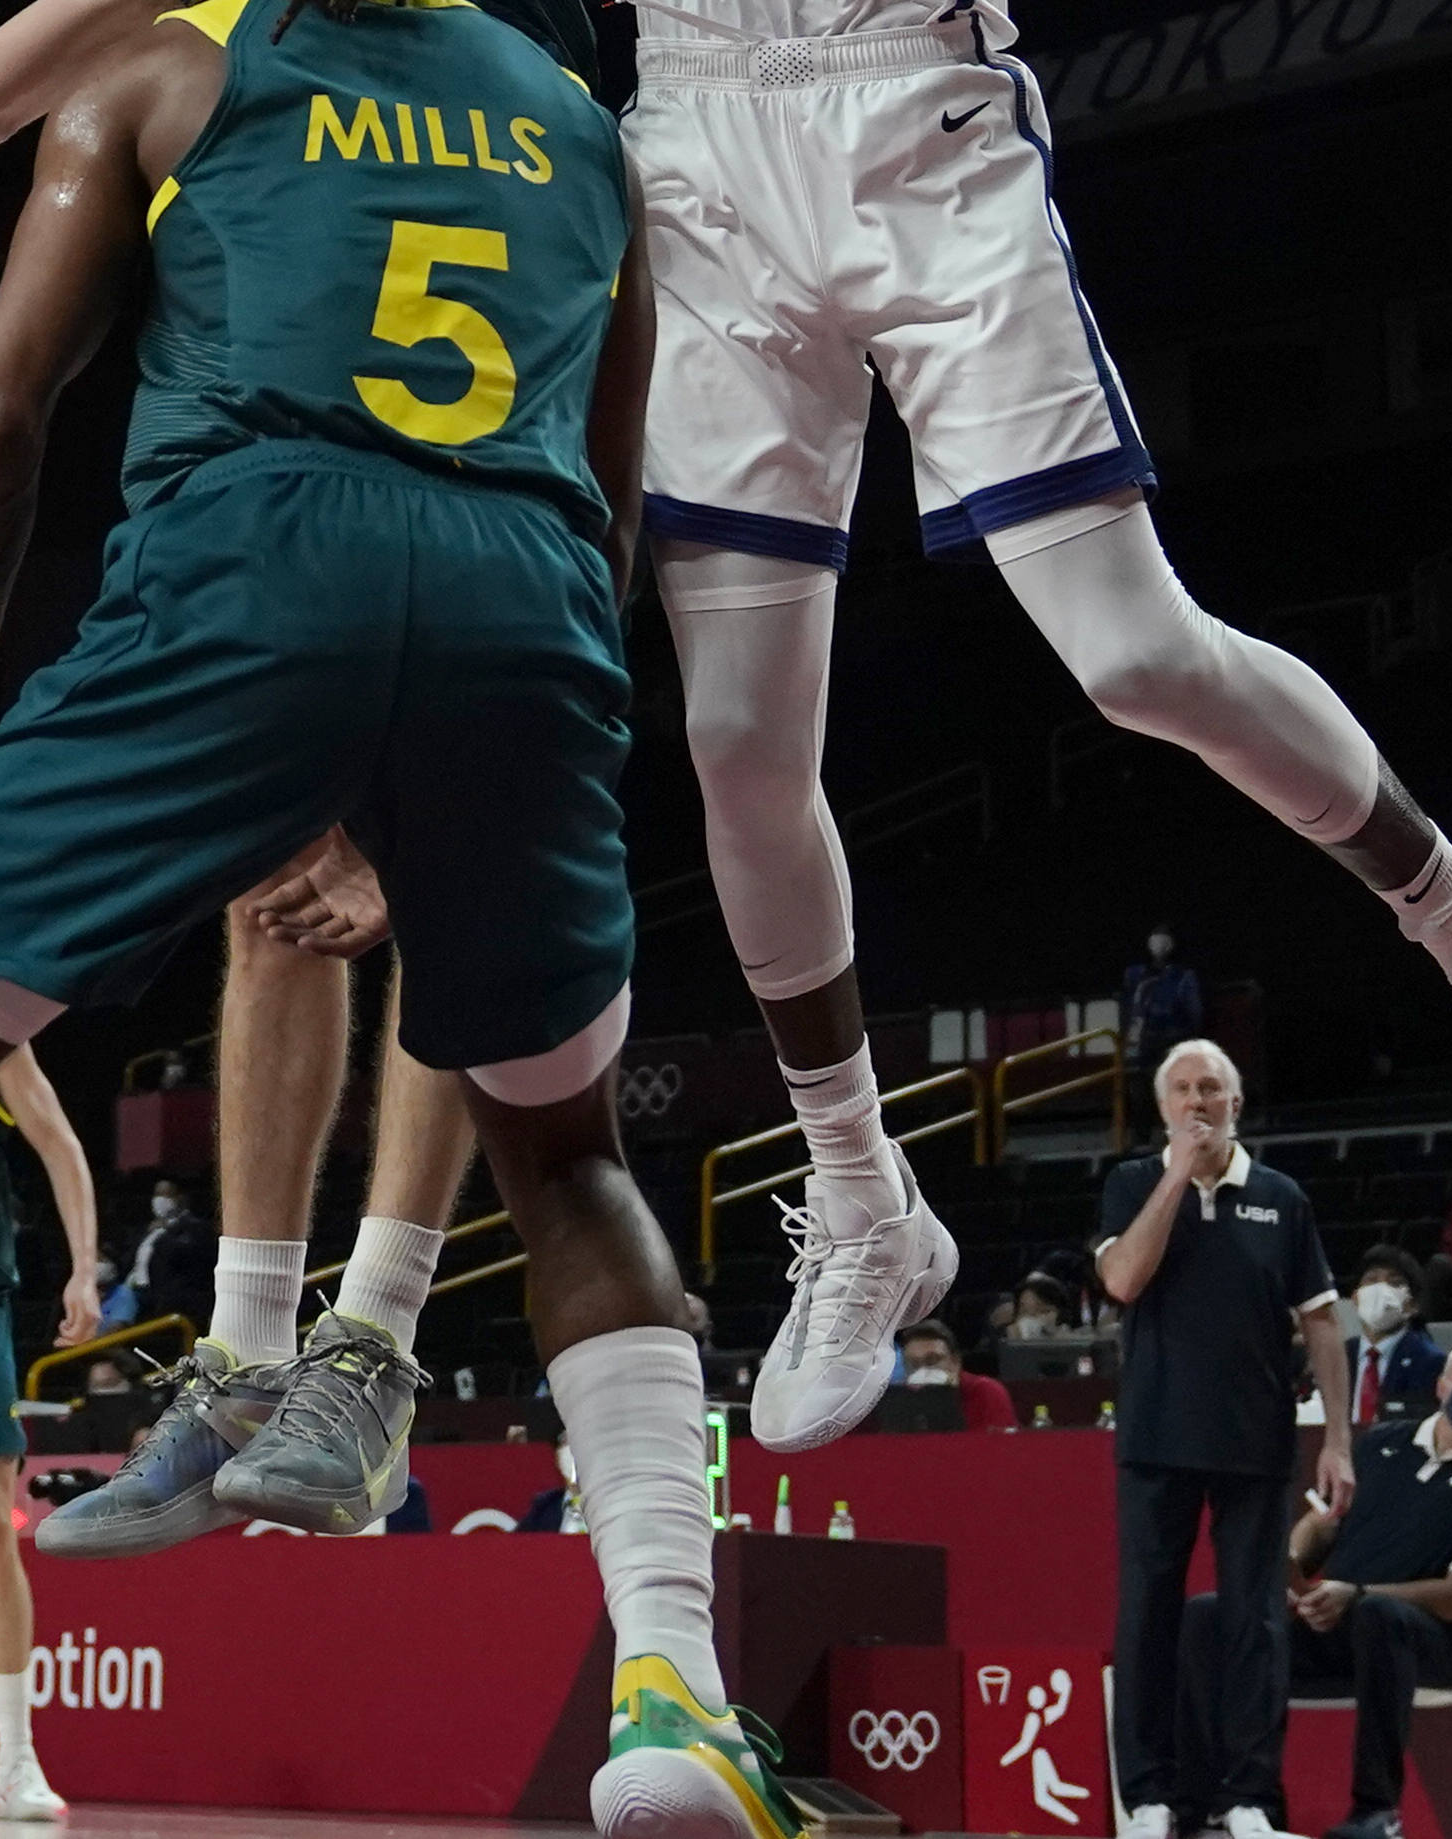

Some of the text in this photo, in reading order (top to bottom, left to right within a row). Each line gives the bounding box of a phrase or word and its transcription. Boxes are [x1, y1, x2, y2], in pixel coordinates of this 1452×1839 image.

[303, 94, 553, 185] MILLS
[352, 220, 516, 446] 5
[1234, 1202, 1280, 1226] USA
